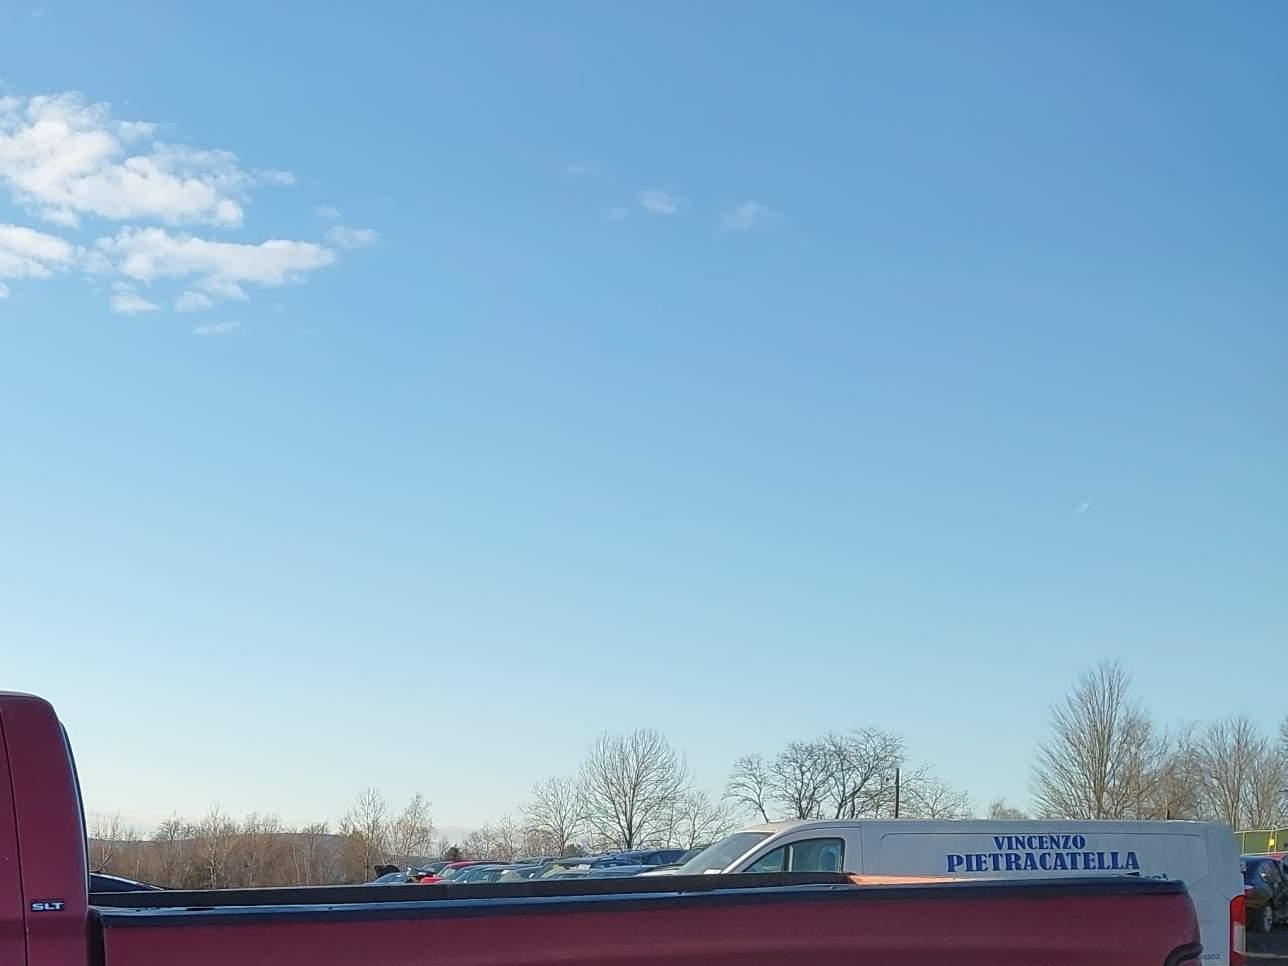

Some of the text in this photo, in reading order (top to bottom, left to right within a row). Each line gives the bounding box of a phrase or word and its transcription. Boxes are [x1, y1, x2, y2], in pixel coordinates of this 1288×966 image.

[993, 834, 1086, 851] VINCENZO
[946, 851, 1140, 873] PIETRACATELLA
[31, 902, 65, 911] SLT
